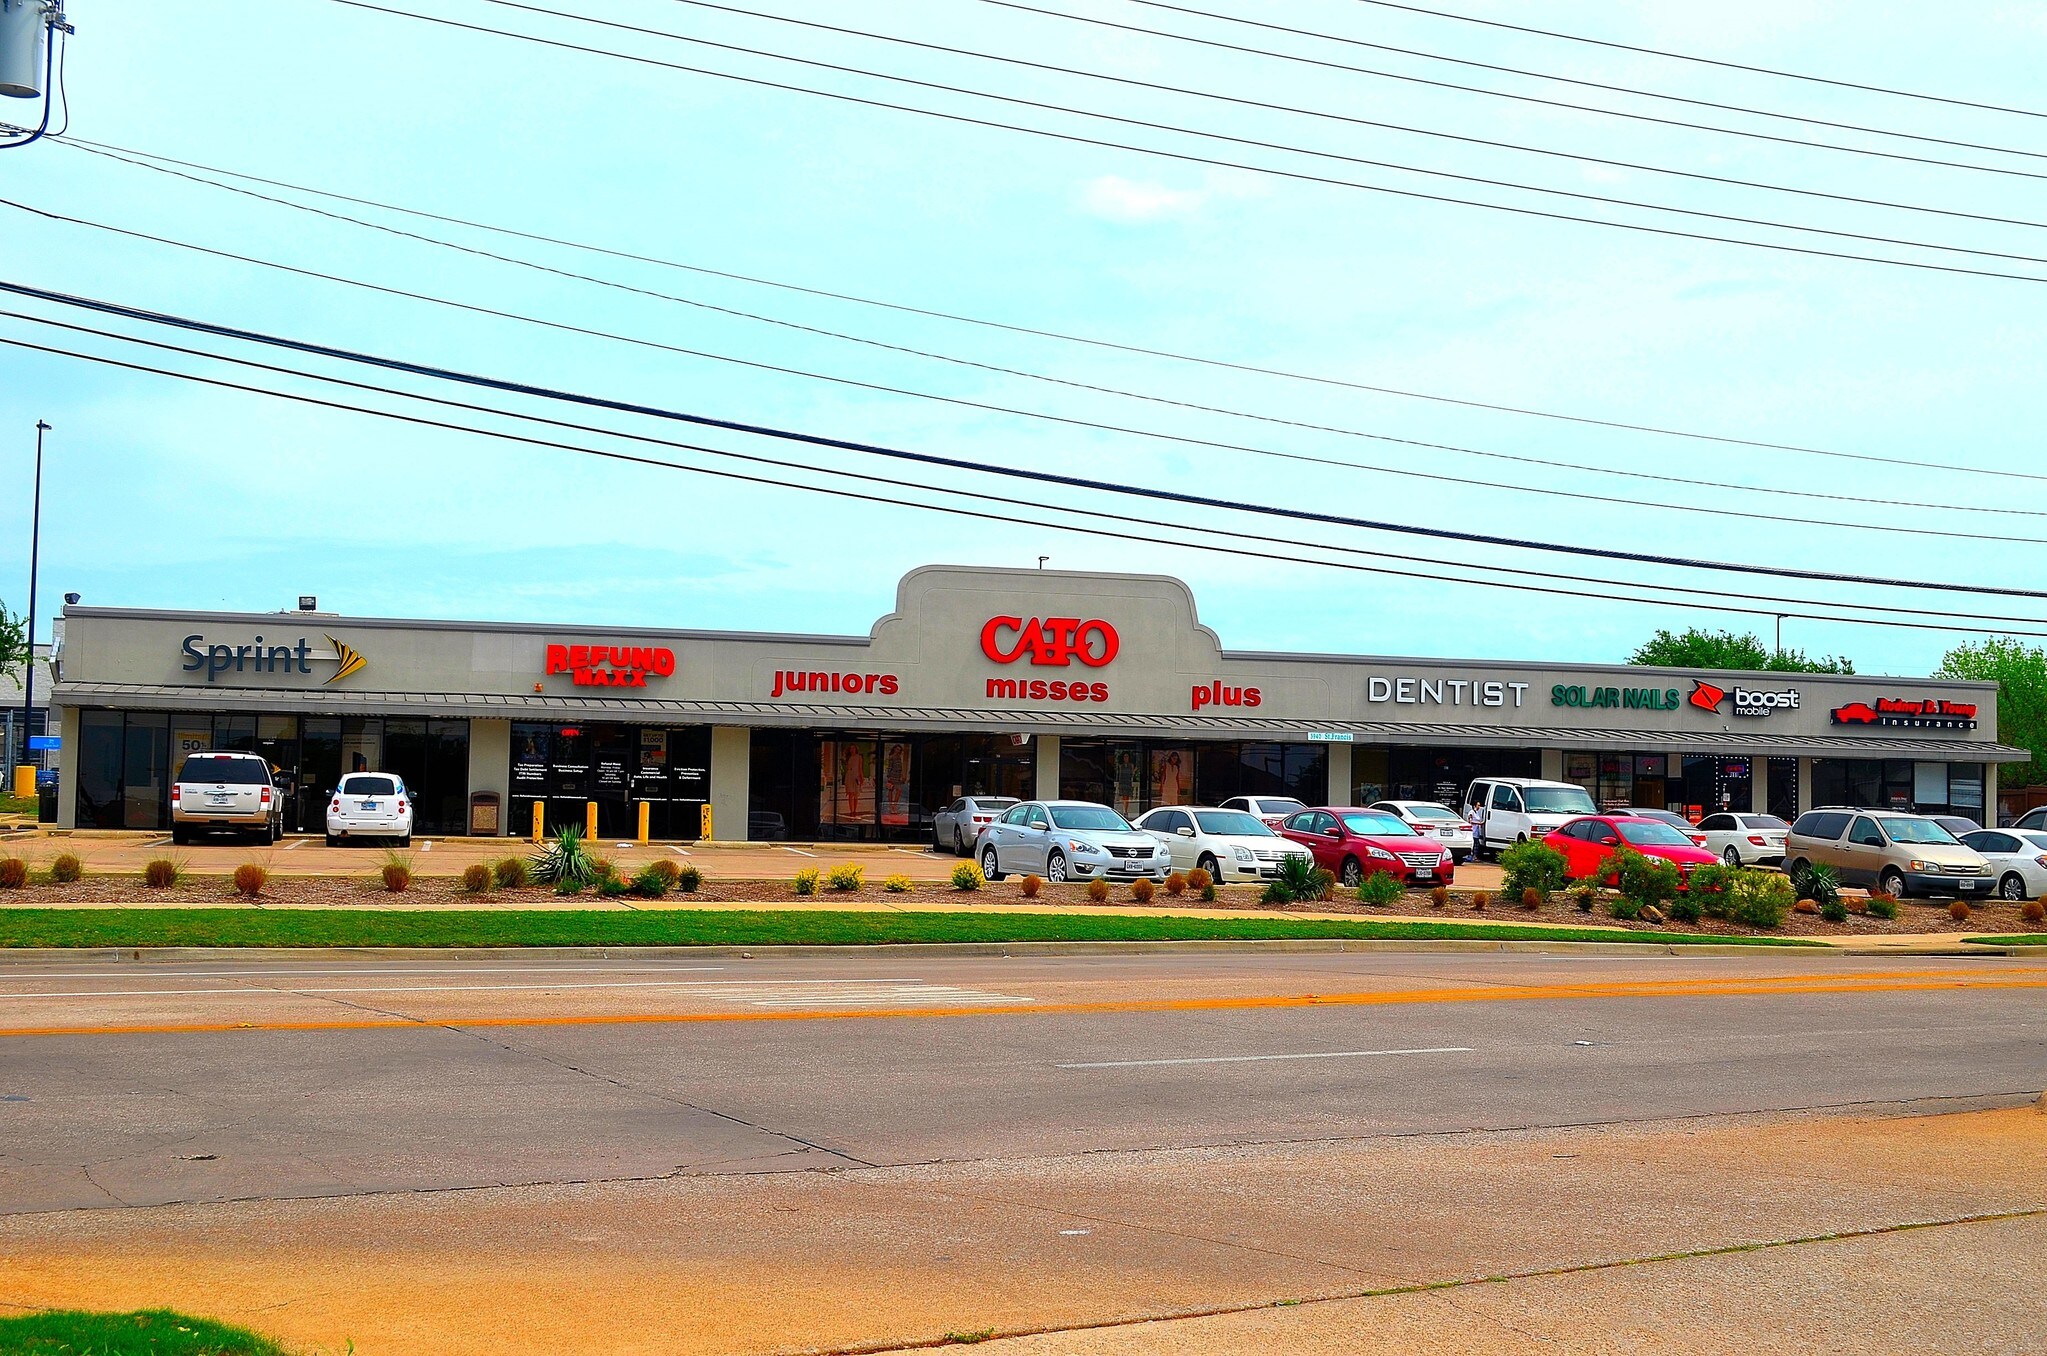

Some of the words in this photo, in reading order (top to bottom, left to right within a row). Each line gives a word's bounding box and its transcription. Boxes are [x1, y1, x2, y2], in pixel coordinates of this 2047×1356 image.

[981, 616, 1119, 666] CATO
[182, 634, 312, 681] Sprint
[547, 645, 675, 676] REFUND
[573, 668, 647, 688] MAXX
[771, 671, 899, 697] juniors
[986, 679, 1109, 701] misses
[1192, 681, 1261, 711] plus
[1368, 677, 1529, 707] DENTIST
[1551, 685, 1619, 707] SOLAR
[1623, 687, 1681, 710] NAILS
[1735, 687, 1799, 708] boost
[1736, 707, 1770, 716] mobile
[1878, 698, 1922, 716] Rodney
[1926, 700, 1937, 713] D.
[1942, 701, 1977, 718] Young
[1882, 717, 1976, 729] Insurance
